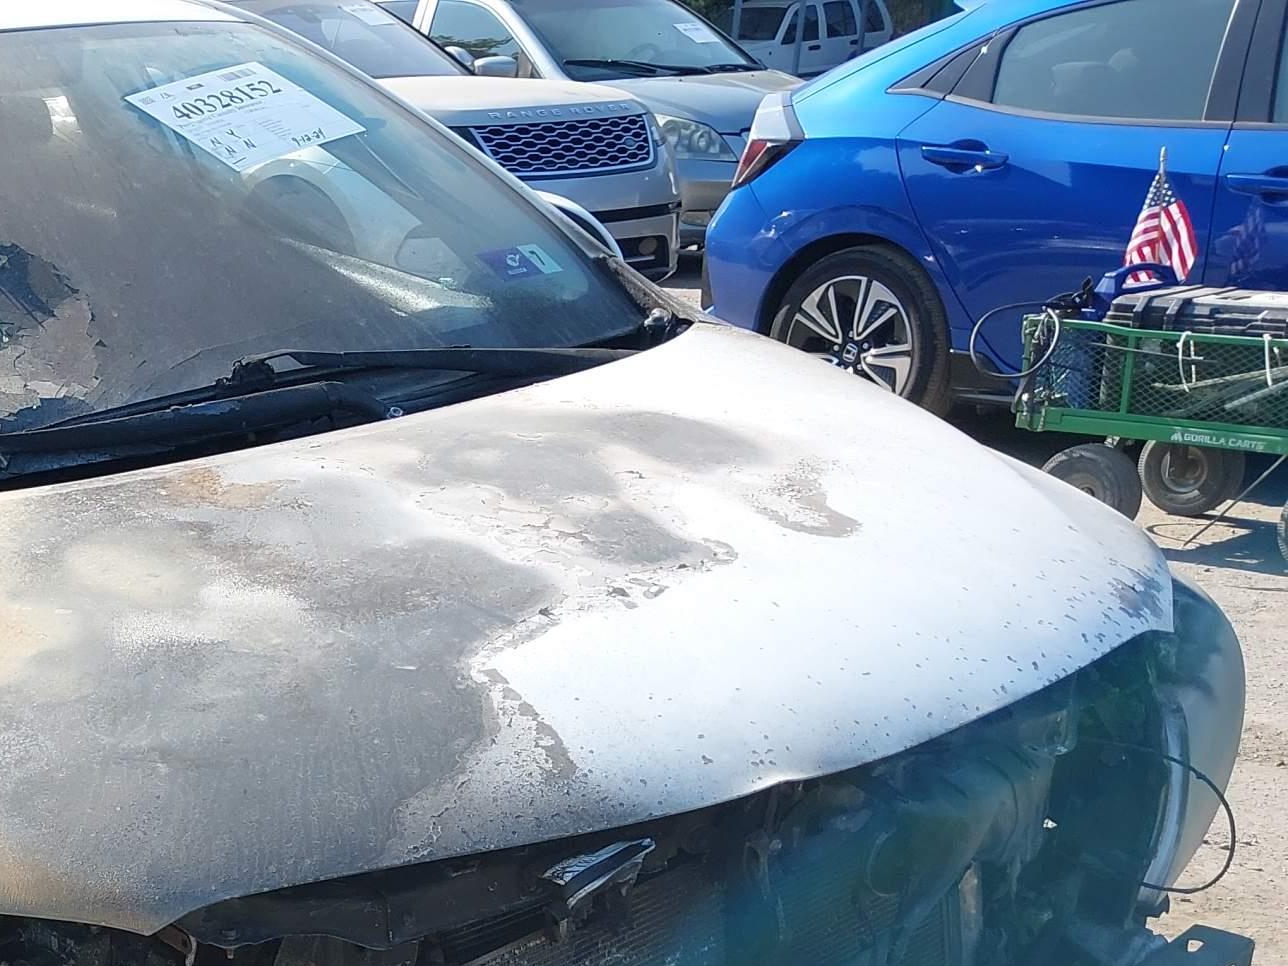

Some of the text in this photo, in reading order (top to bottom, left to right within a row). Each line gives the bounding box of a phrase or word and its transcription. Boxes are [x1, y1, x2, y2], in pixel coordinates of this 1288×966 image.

[171, 79, 283, 120] 40328152
[487, 103, 631, 120] RANGE ROVER
[1184, 433, 1226, 445] GORILLA
